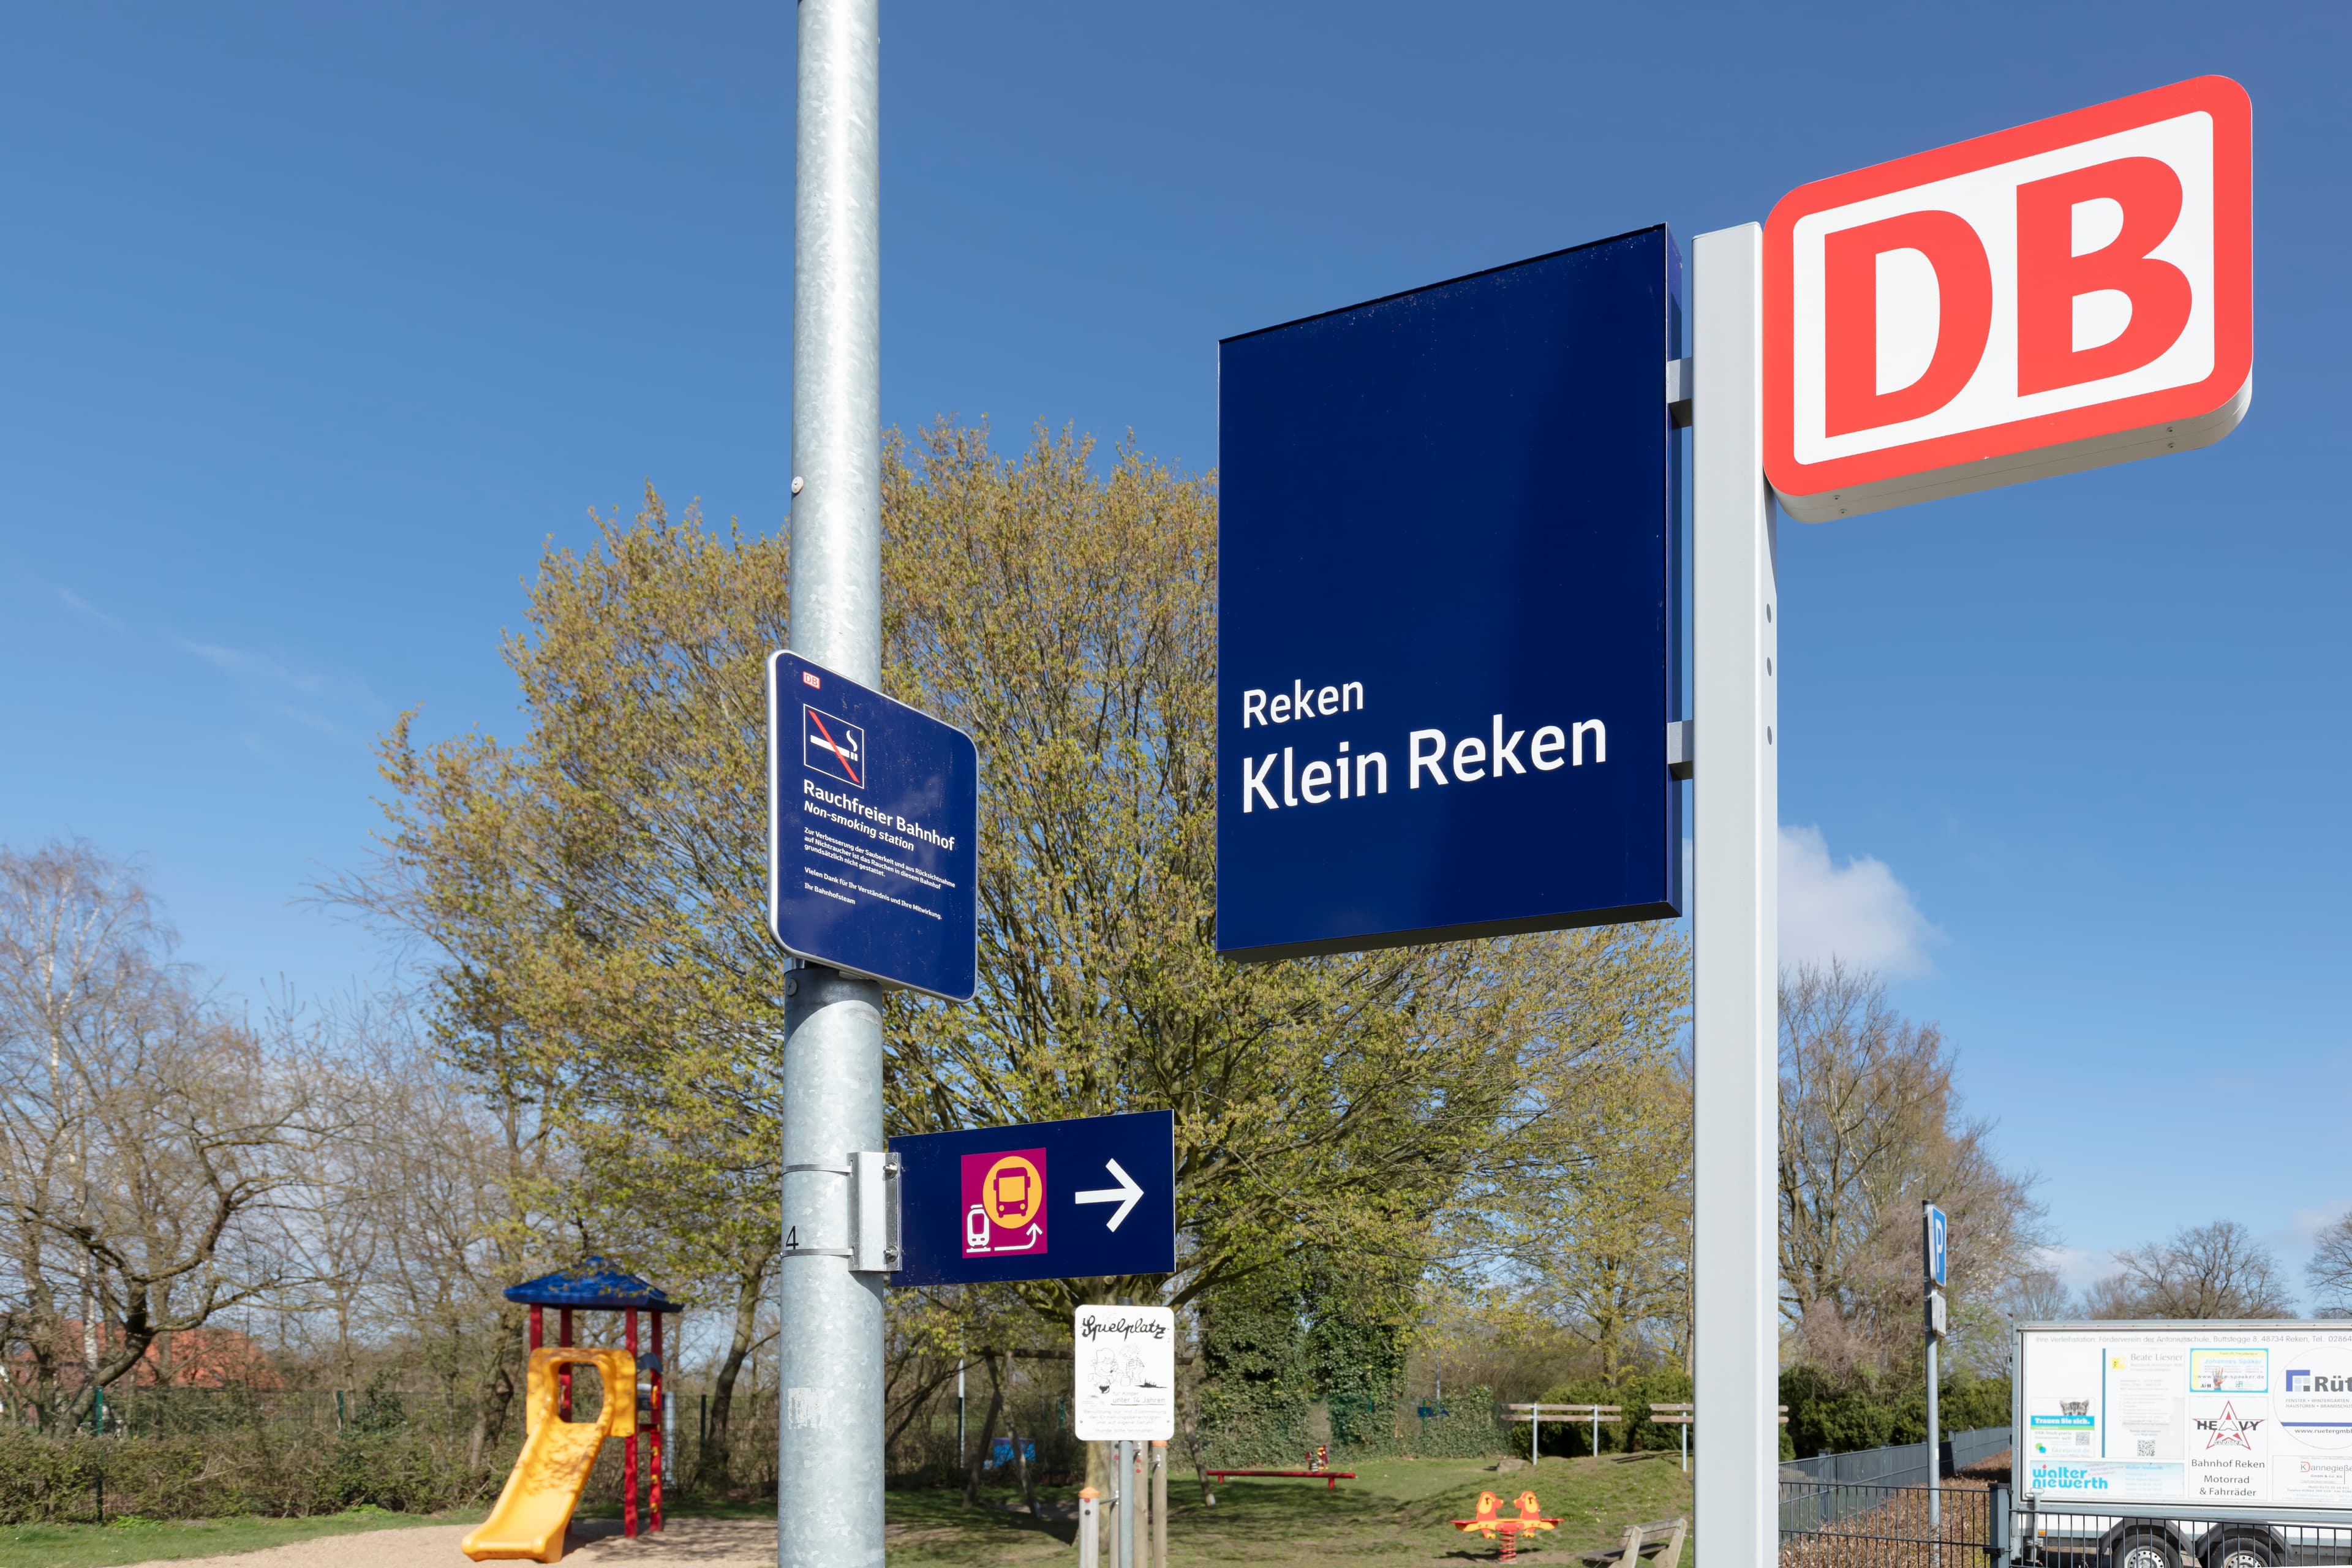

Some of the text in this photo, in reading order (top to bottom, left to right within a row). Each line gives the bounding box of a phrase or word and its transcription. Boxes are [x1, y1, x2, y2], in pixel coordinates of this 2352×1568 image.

[1825, 156, 2193, 439] DB
[805, 674, 818, 687] DB
[1243, 679, 1363, 729] Reken
[1243, 714, 1606, 813] Klein Reken
[804, 778, 955, 851] Rauchfreier Bahnhof
[804, 800, 914, 851] Non-smoking station
[804, 827, 815, 835] Zur
[815, 831, 854, 851] Verbesserung
[865, 849, 894, 865] Sauberkeit
[894, 861, 905, 869] und
[915, 868, 956, 888] Rücksichtnahme
[804, 844, 886, 877] grundsätzlich nicht gestattet.
[815, 839, 851, 857] Nichtraucher
[871, 859, 894, 873] Rauchen
[900, 870, 919, 882] diesem
[920, 877, 941, 890] Bahnhof
[804, 866, 824, 879] Vielen
[824, 873, 839, 884] Dank
[848, 881, 857, 890] Ihr
[858, 885, 890, 901] Verständnis
[891, 896, 901, 905] und
[901, 900, 912, 909] Ihre
[913, 904, 943, 920] Mitwirkung.
[804, 882, 856, 905] Ihr Bahnhofsteam
[785, 1225, 799, 1250] 4
[1936, 1218, 1943, 1273] P
[1082, 1315, 1166, 1342] Spielplatz
[2315, 1376, 2352, 1392] Rüt
[2197, 1420, 2260, 1431] HEAVY
[2032, 1466, 2088, 1479] walter
[2192, 1459, 2265, 1469] Bahnhof Reken
[2032, 1477, 2108, 1489] niewerth
[2204, 1475, 2250, 1483] Motorrad
[2209, 1487, 2256, 1496] Fahrräder
